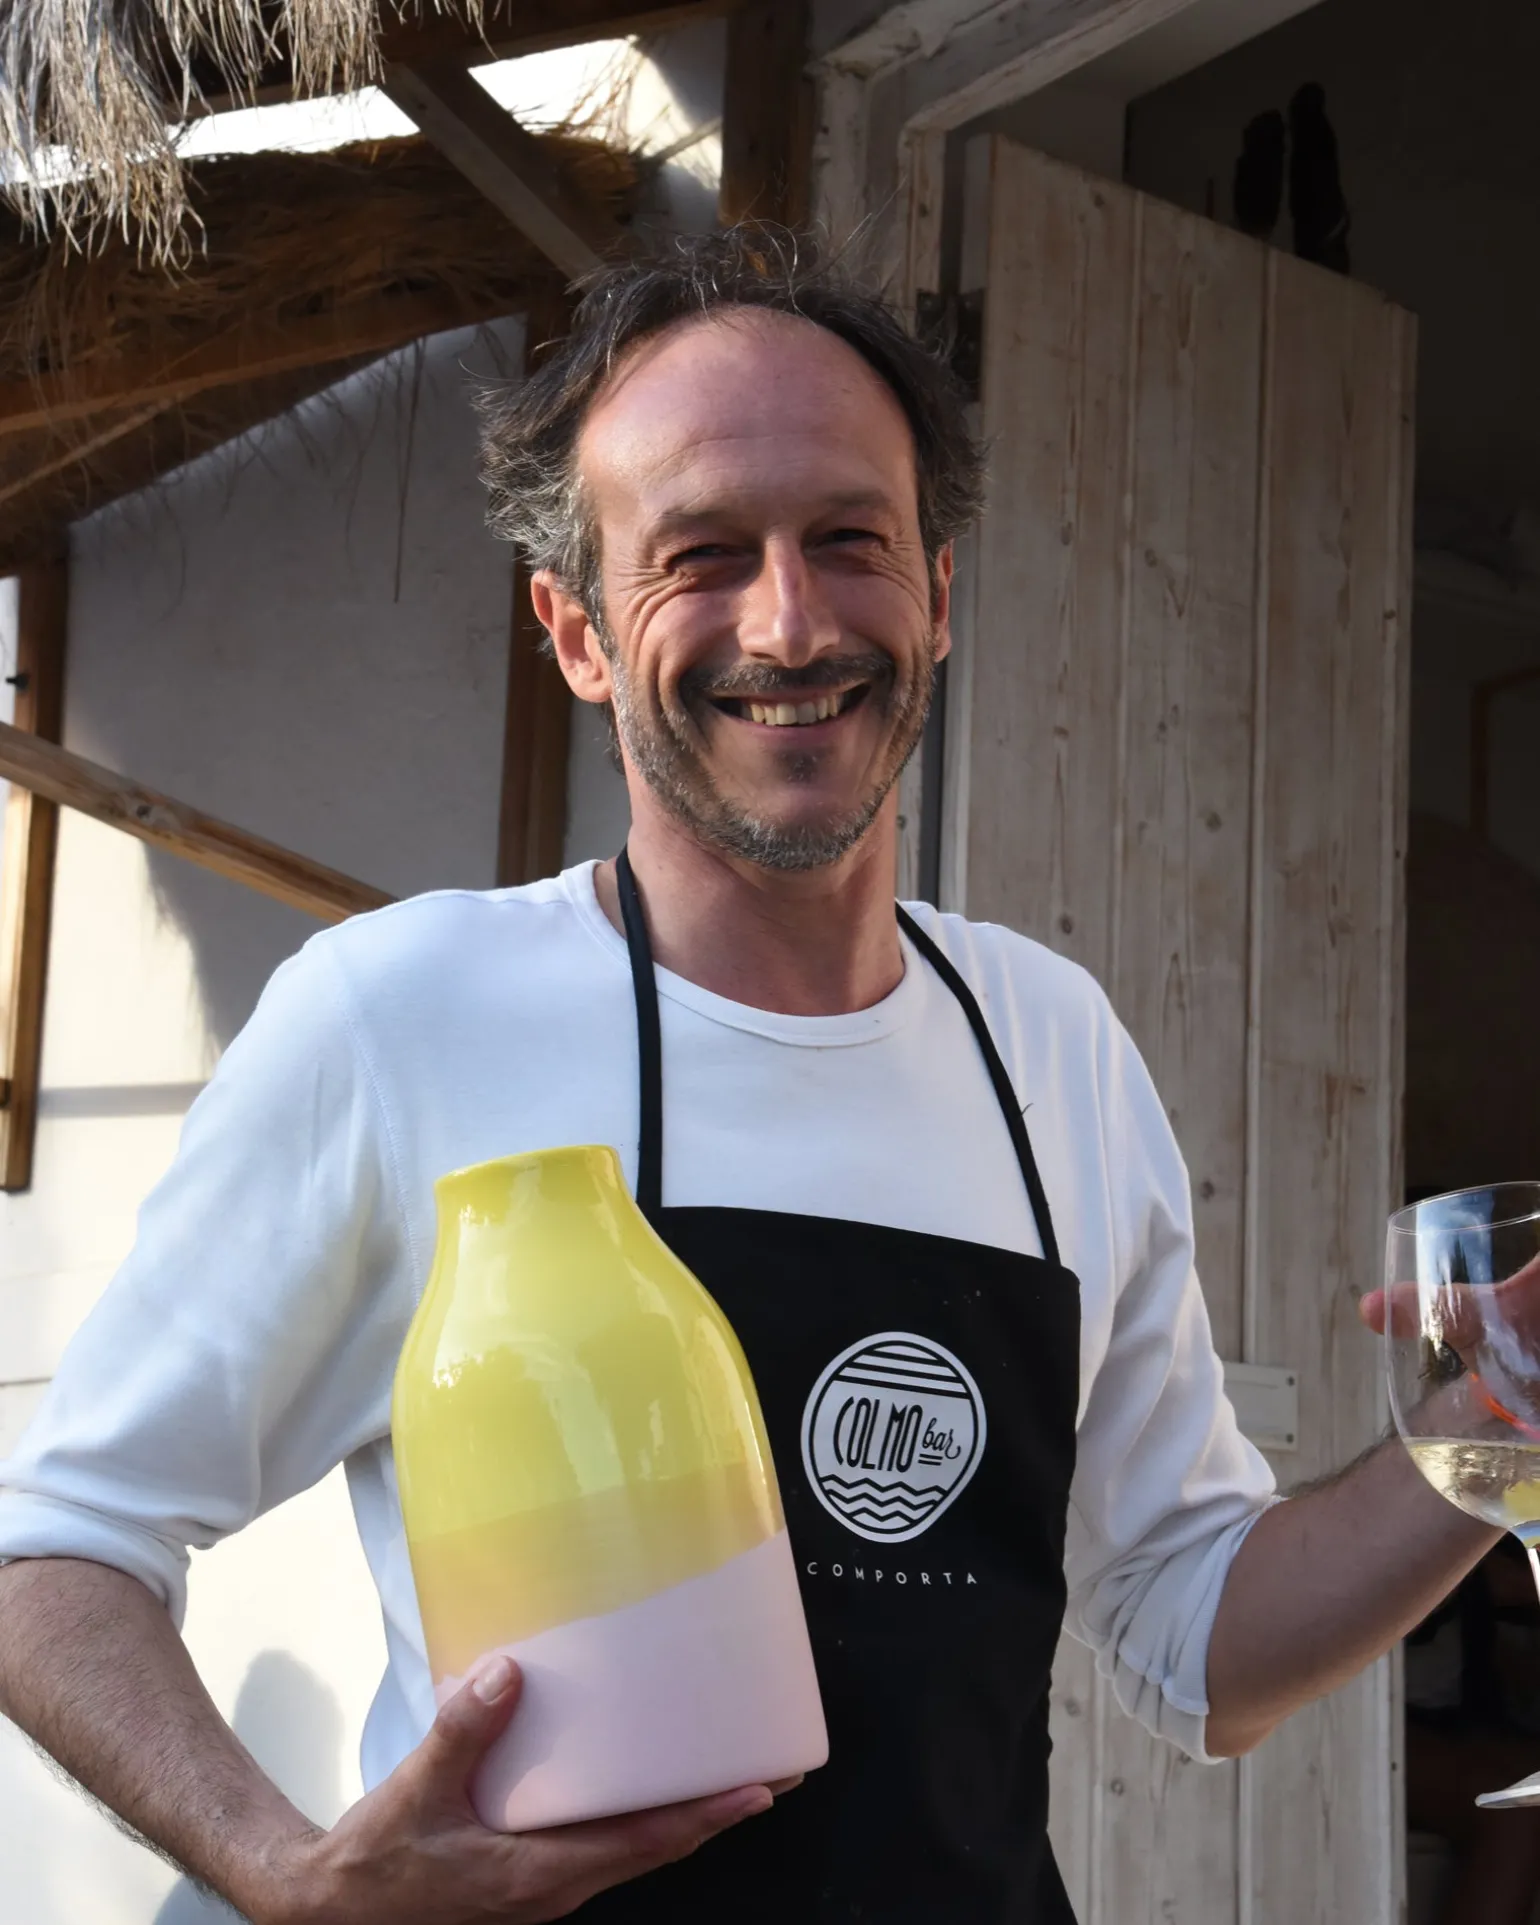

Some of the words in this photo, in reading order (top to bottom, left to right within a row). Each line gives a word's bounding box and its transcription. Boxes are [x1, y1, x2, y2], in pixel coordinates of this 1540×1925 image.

[833, 1396, 923, 1473] COLMO
[922, 1417, 961, 1460] bar
[807, 1561, 977, 1585] COMPORTA
